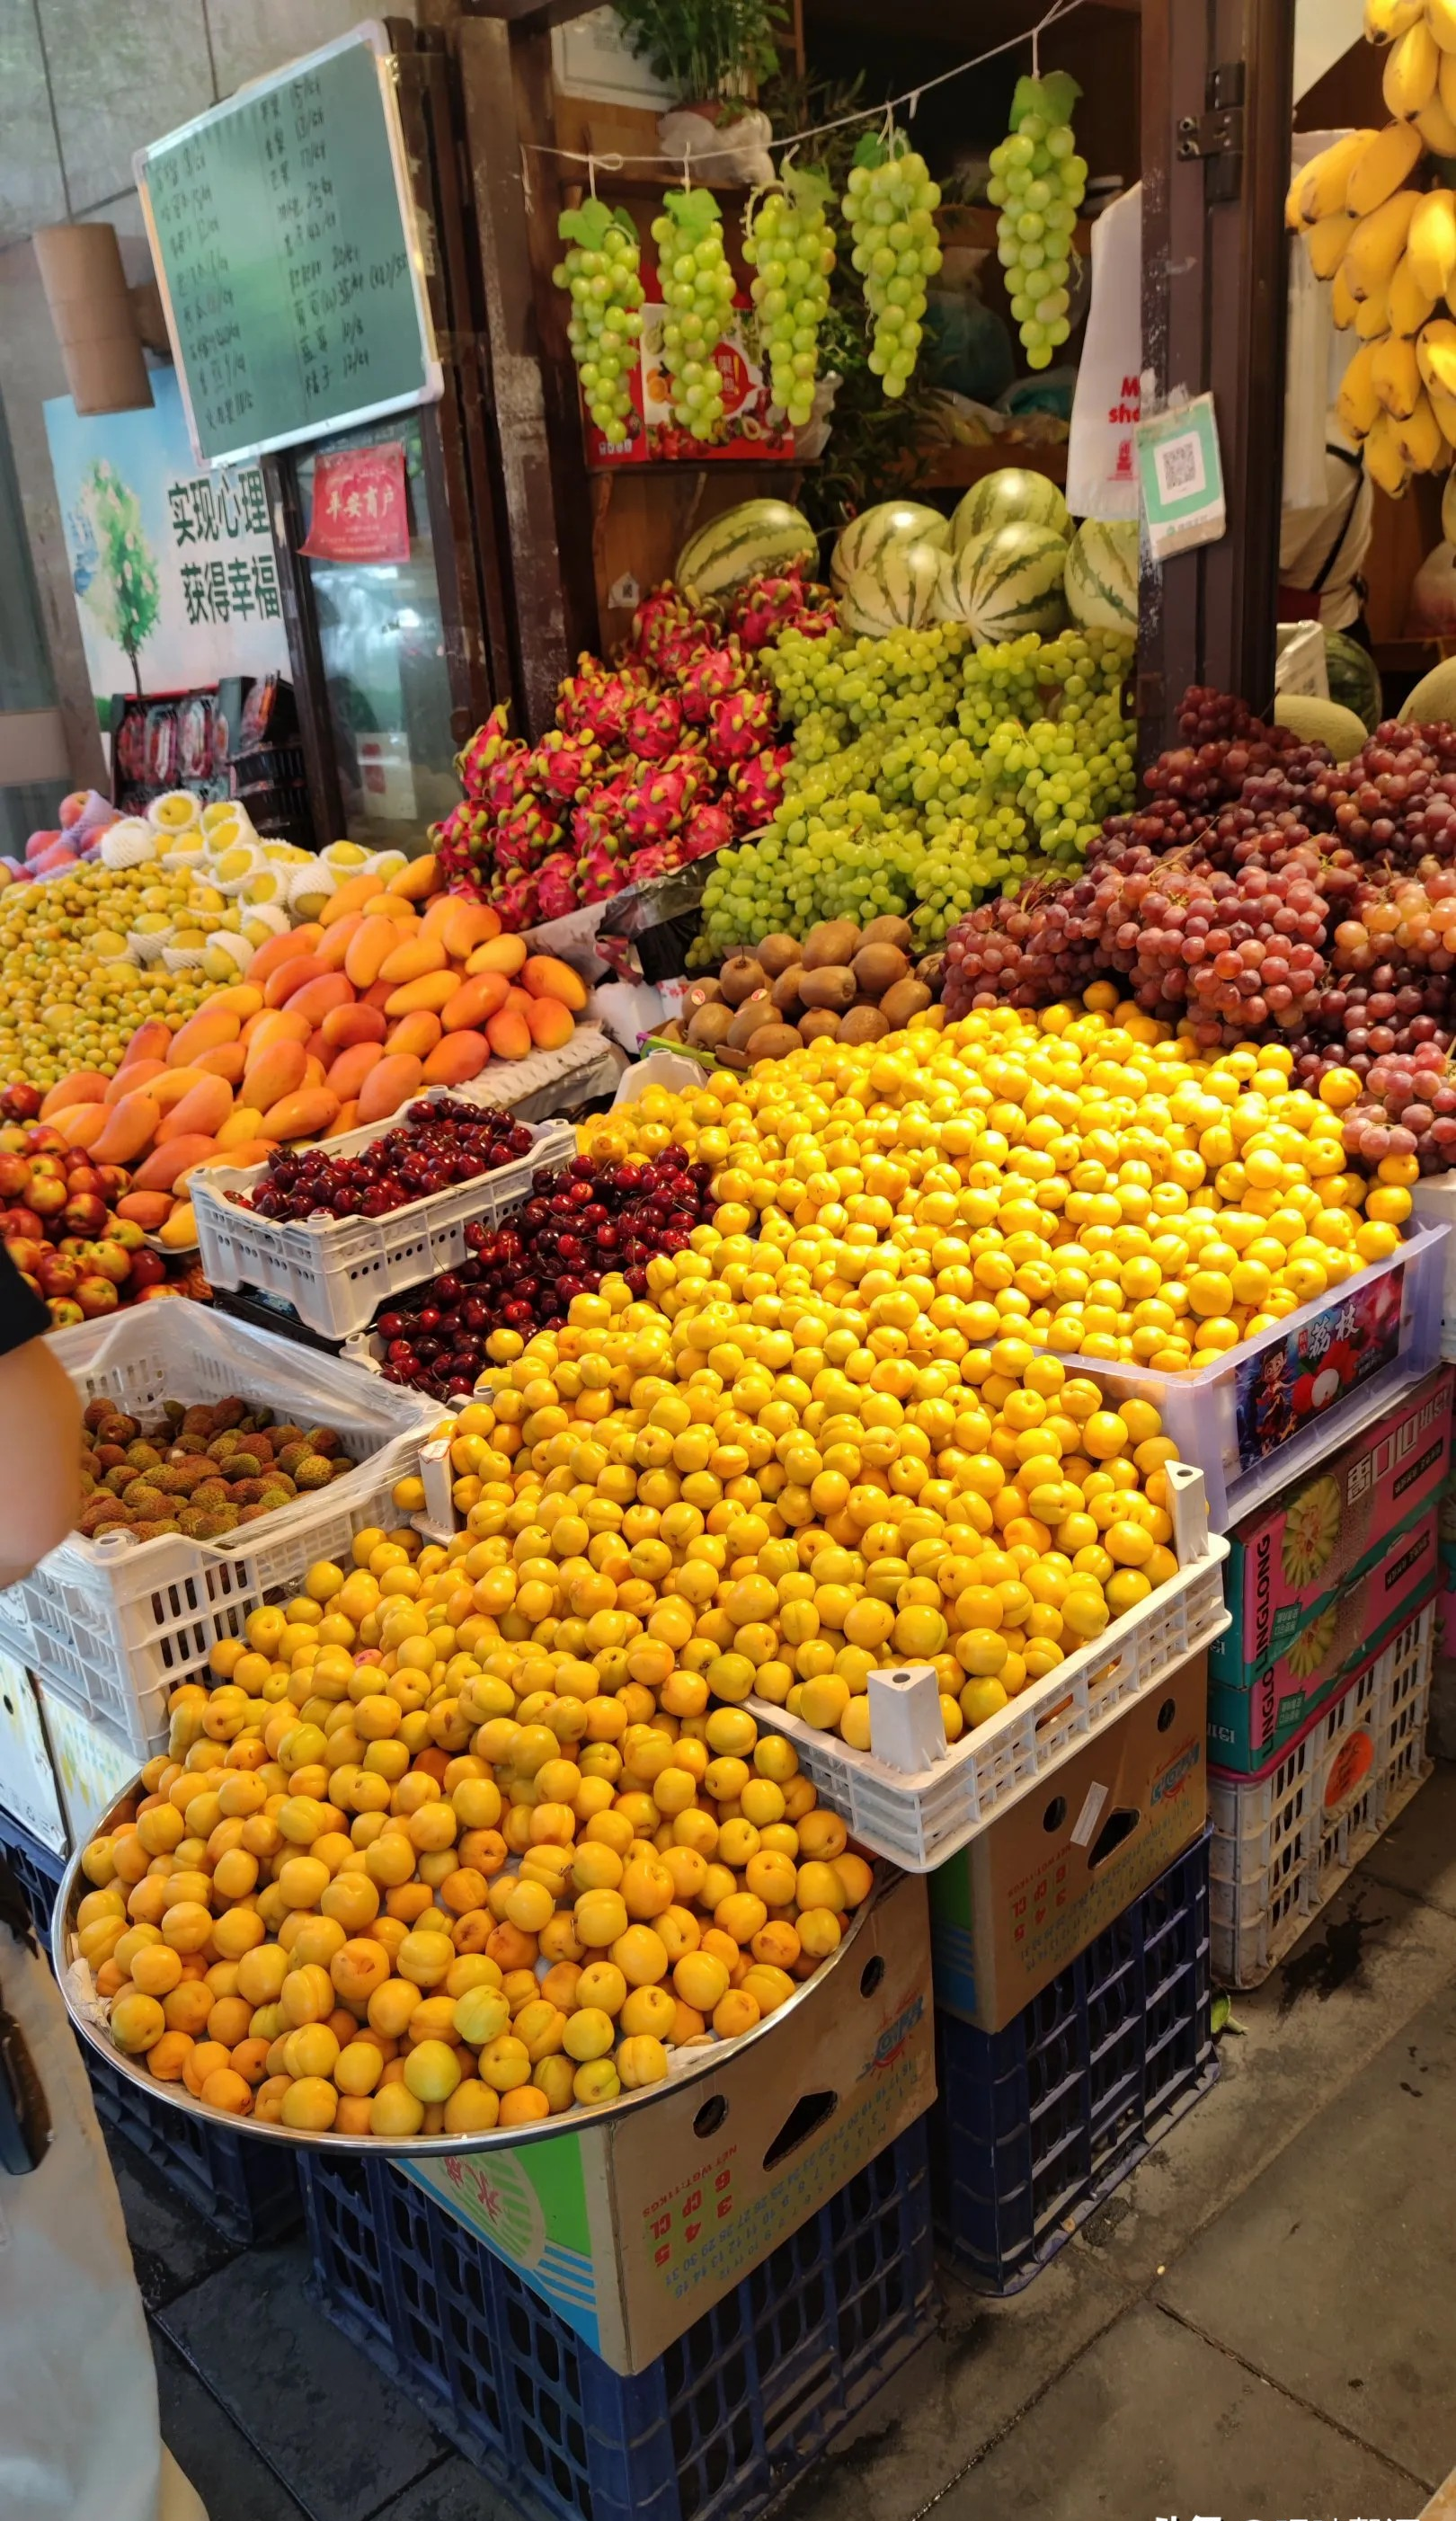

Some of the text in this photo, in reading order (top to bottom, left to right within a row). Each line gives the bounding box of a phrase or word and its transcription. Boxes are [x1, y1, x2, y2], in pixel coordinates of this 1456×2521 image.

[168, 470, 271, 546] 实现心理
[181, 555, 280, 625] 获得幸福
[1310, 1303, 1360, 1359] 荔枝
[1256, 1533, 1271, 1673] LINGLONG
[1014, 1888, 1066, 1941] 3 4 5
[715, 2143, 736, 2167] NET
[650, 2170, 731, 2239] 6 CP CL
[654, 2195, 732, 2267] 3 4 5
